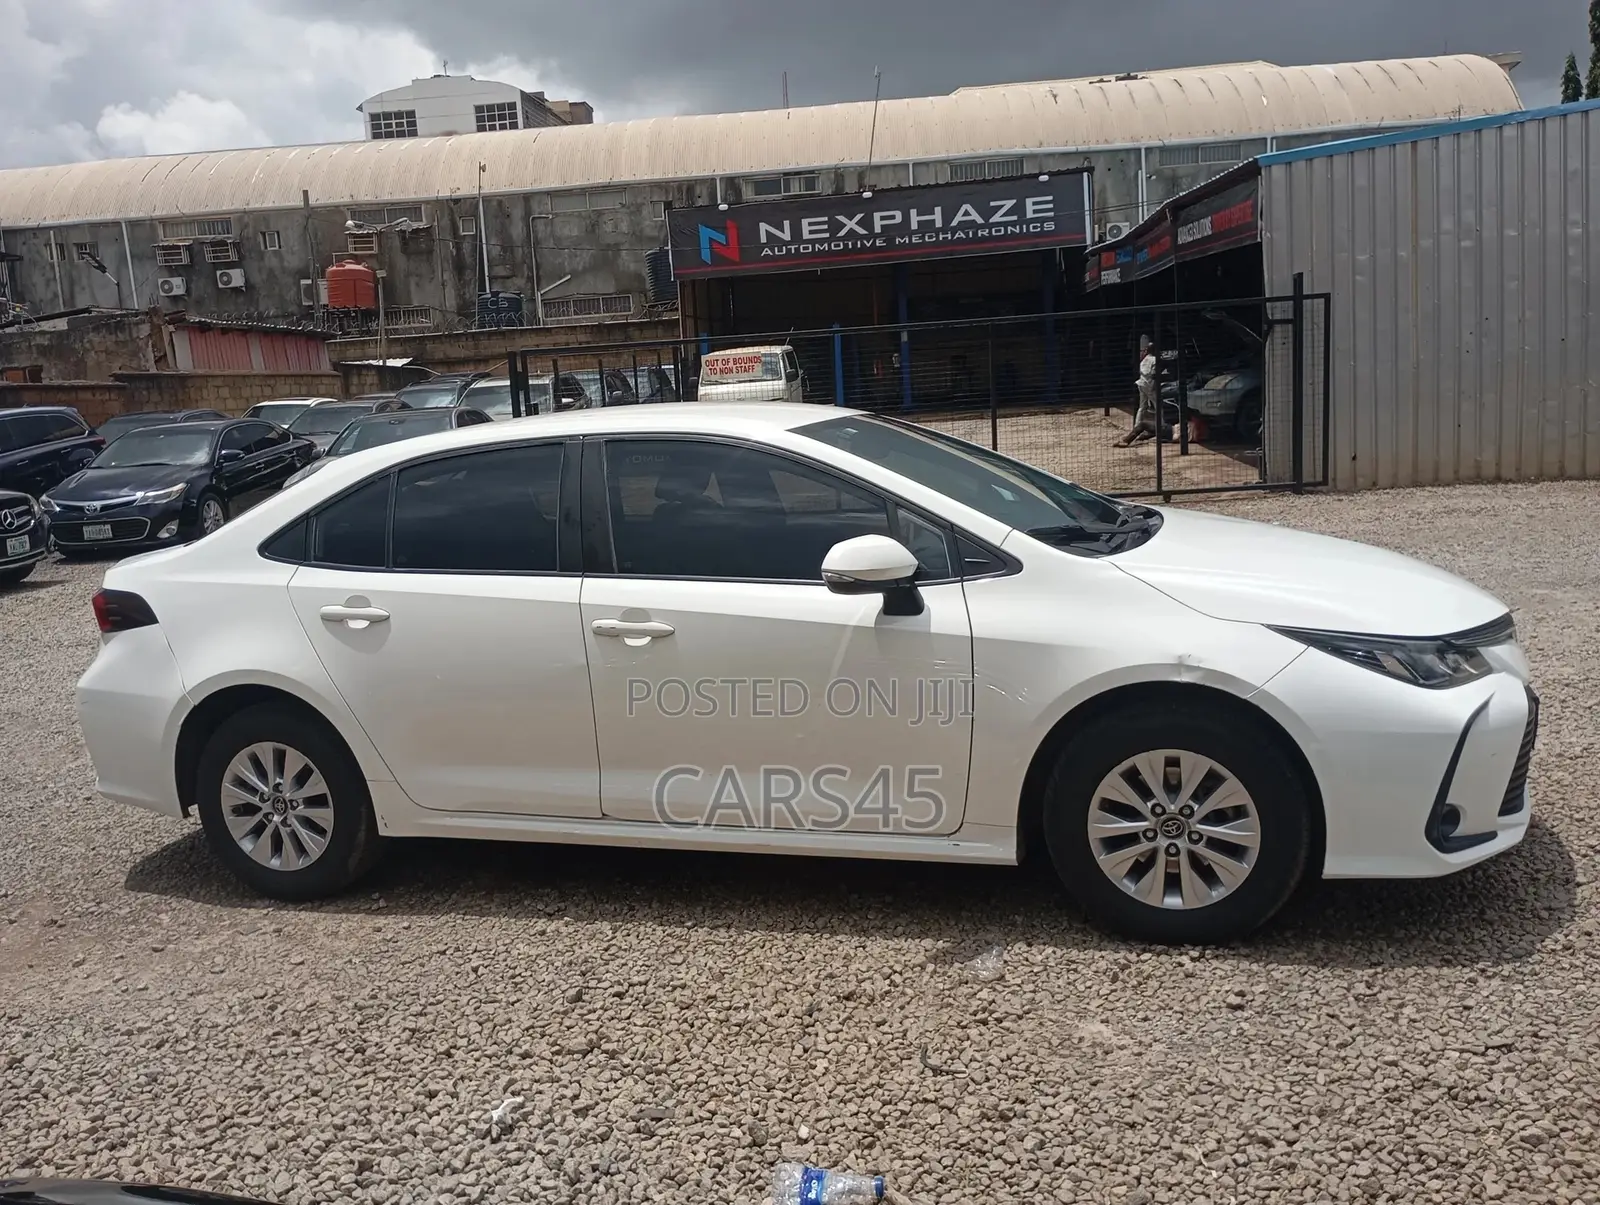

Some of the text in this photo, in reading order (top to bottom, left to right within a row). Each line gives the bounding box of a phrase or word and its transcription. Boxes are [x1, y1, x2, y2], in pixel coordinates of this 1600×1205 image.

[758, 195, 1055, 244] NEXPHAZE
[760, 221, 1056, 257] AUTOMOTIVE MECHATRONICS
[705, 356, 762, 367] OUT OF BOUNDS
[709, 365, 755, 376] TO NON STAFF
